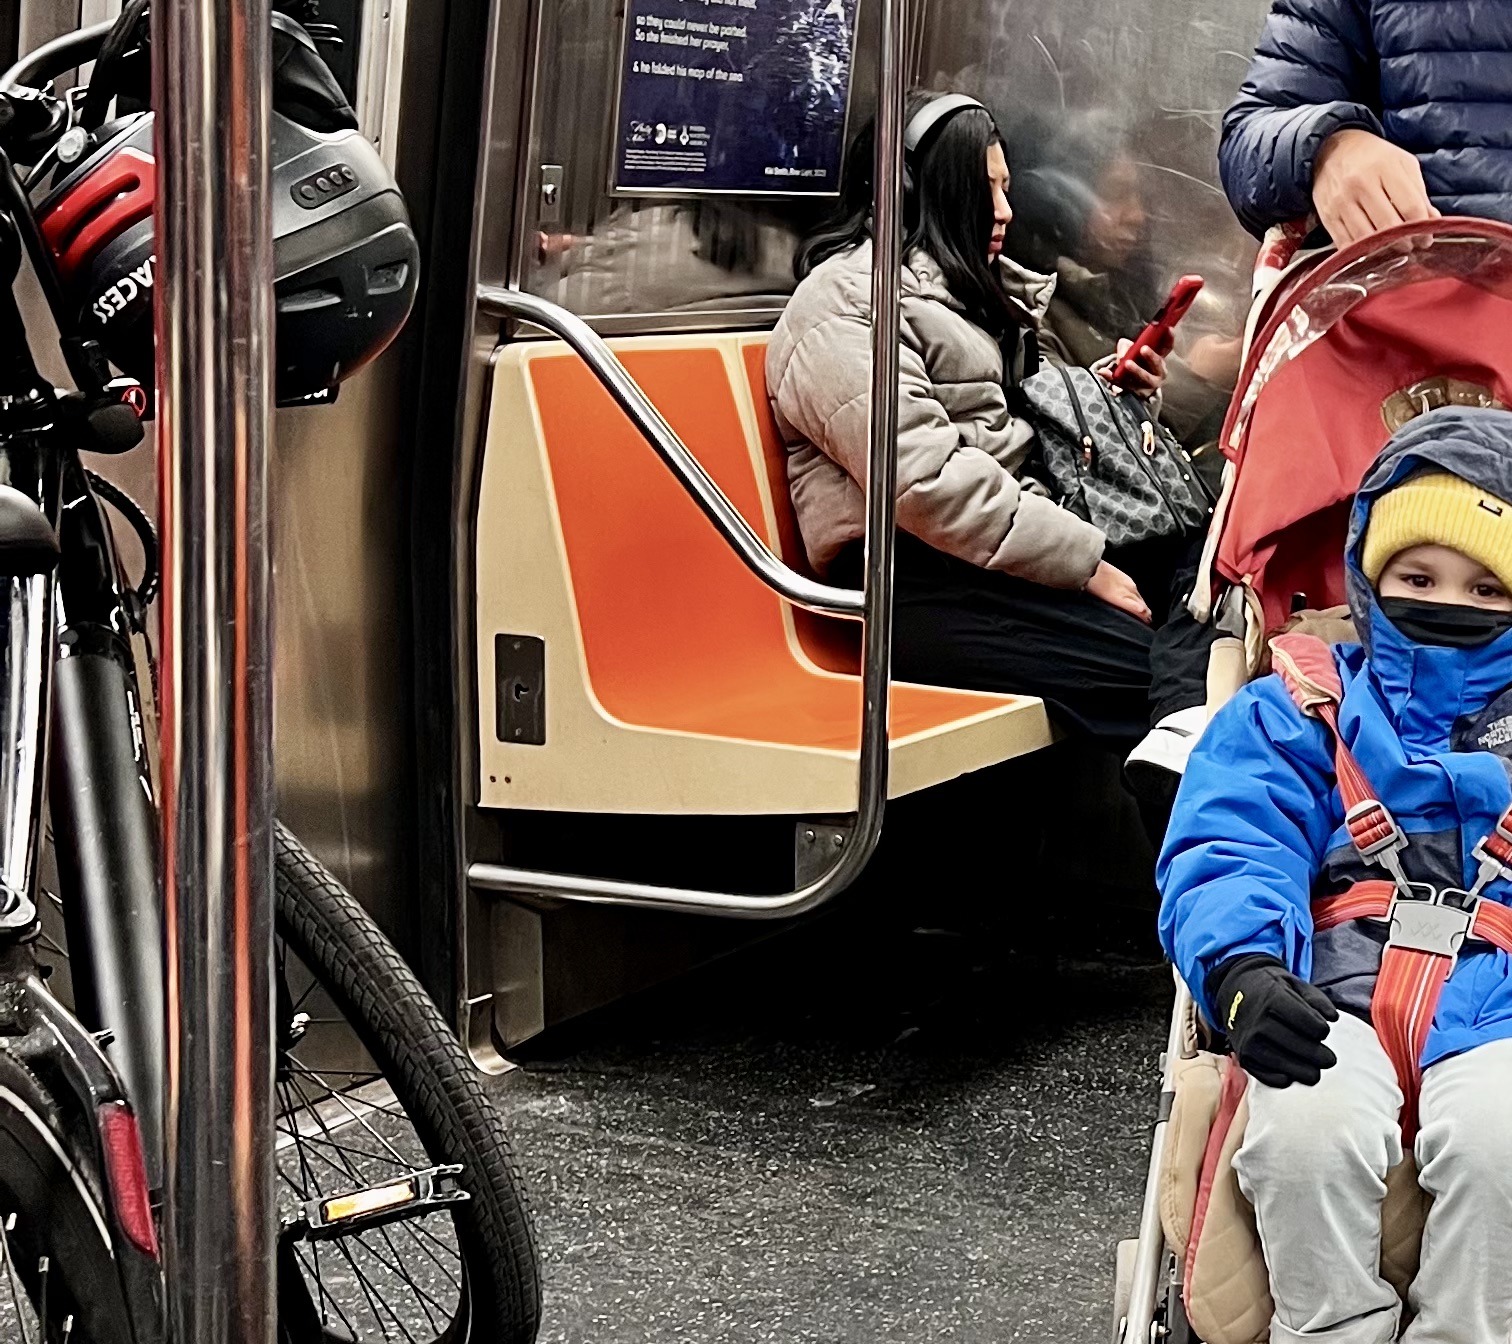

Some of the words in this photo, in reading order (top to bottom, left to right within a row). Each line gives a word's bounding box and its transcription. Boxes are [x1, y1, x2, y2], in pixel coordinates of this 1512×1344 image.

[636, 15, 646, 26] so
[646, 15, 663, 31] they
[663, 18, 686, 30] could
[708, 21, 720, 35] be
[635, 28, 646, 41] So
[646, 30, 659, 43] she
[660, 31, 689, 46] finished
[689, 34, 702, 47] her
[633, 60, 639, 73] &
[640, 60, 650, 74] he
[651, 61, 675, 76] folded
[676, 63, 687, 77] his
[687, 68, 705, 80] map
[705, 67, 715, 79] of
[715, 68, 728, 81] the
[1487, 718, 1506, 731] THE
[1478, 726, 1511, 746] NORTH
